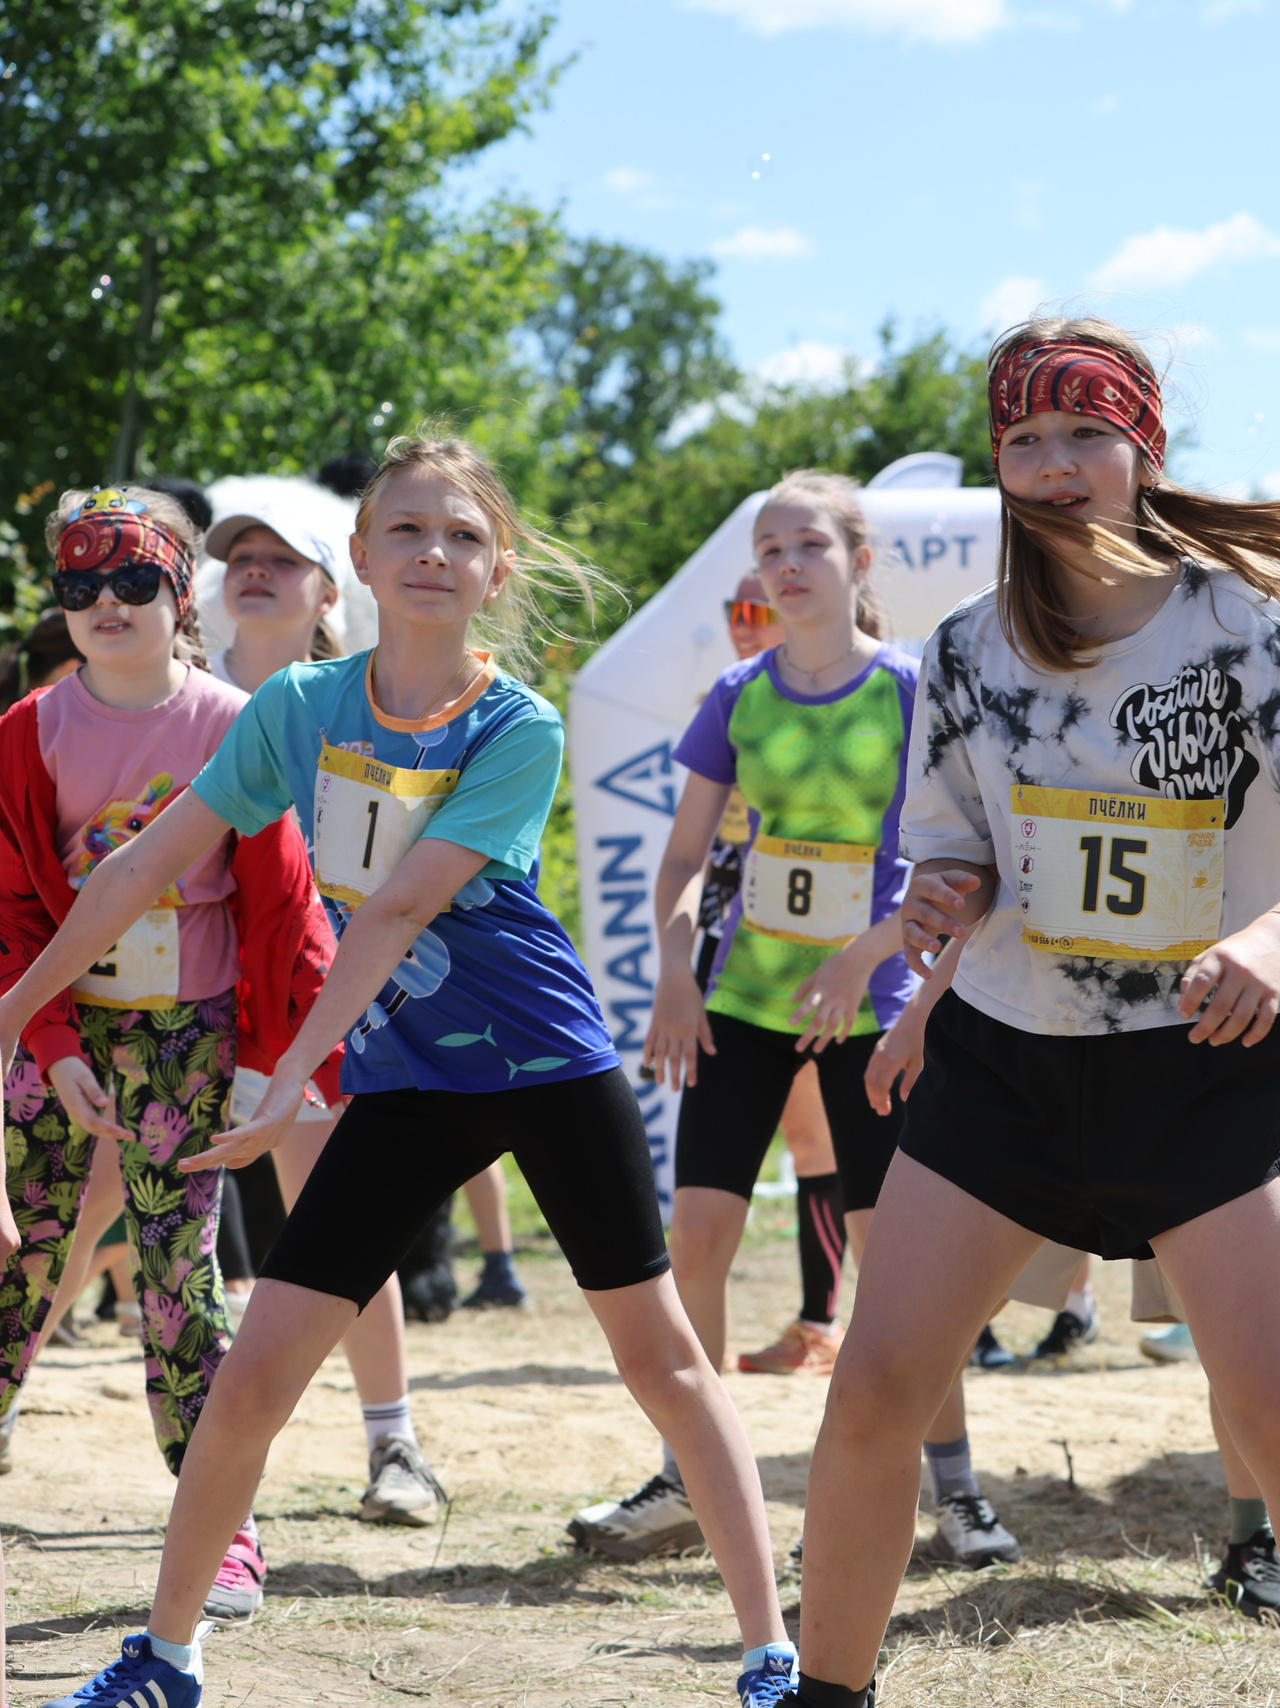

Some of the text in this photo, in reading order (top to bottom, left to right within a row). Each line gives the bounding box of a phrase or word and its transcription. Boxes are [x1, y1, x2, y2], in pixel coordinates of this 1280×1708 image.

[892, 535, 978, 571] АРТ
[1110, 667, 1228, 739] Positive
[364, 762, 391, 788] ПЧЁЛКИ
[1131, 711, 1241, 784] Vibes
[362, 801, 378, 870] 1
[1089, 797, 1146, 820] ПЧЁЛКИ
[787, 867, 813, 917] 8
[1080, 835, 1147, 916] 15
